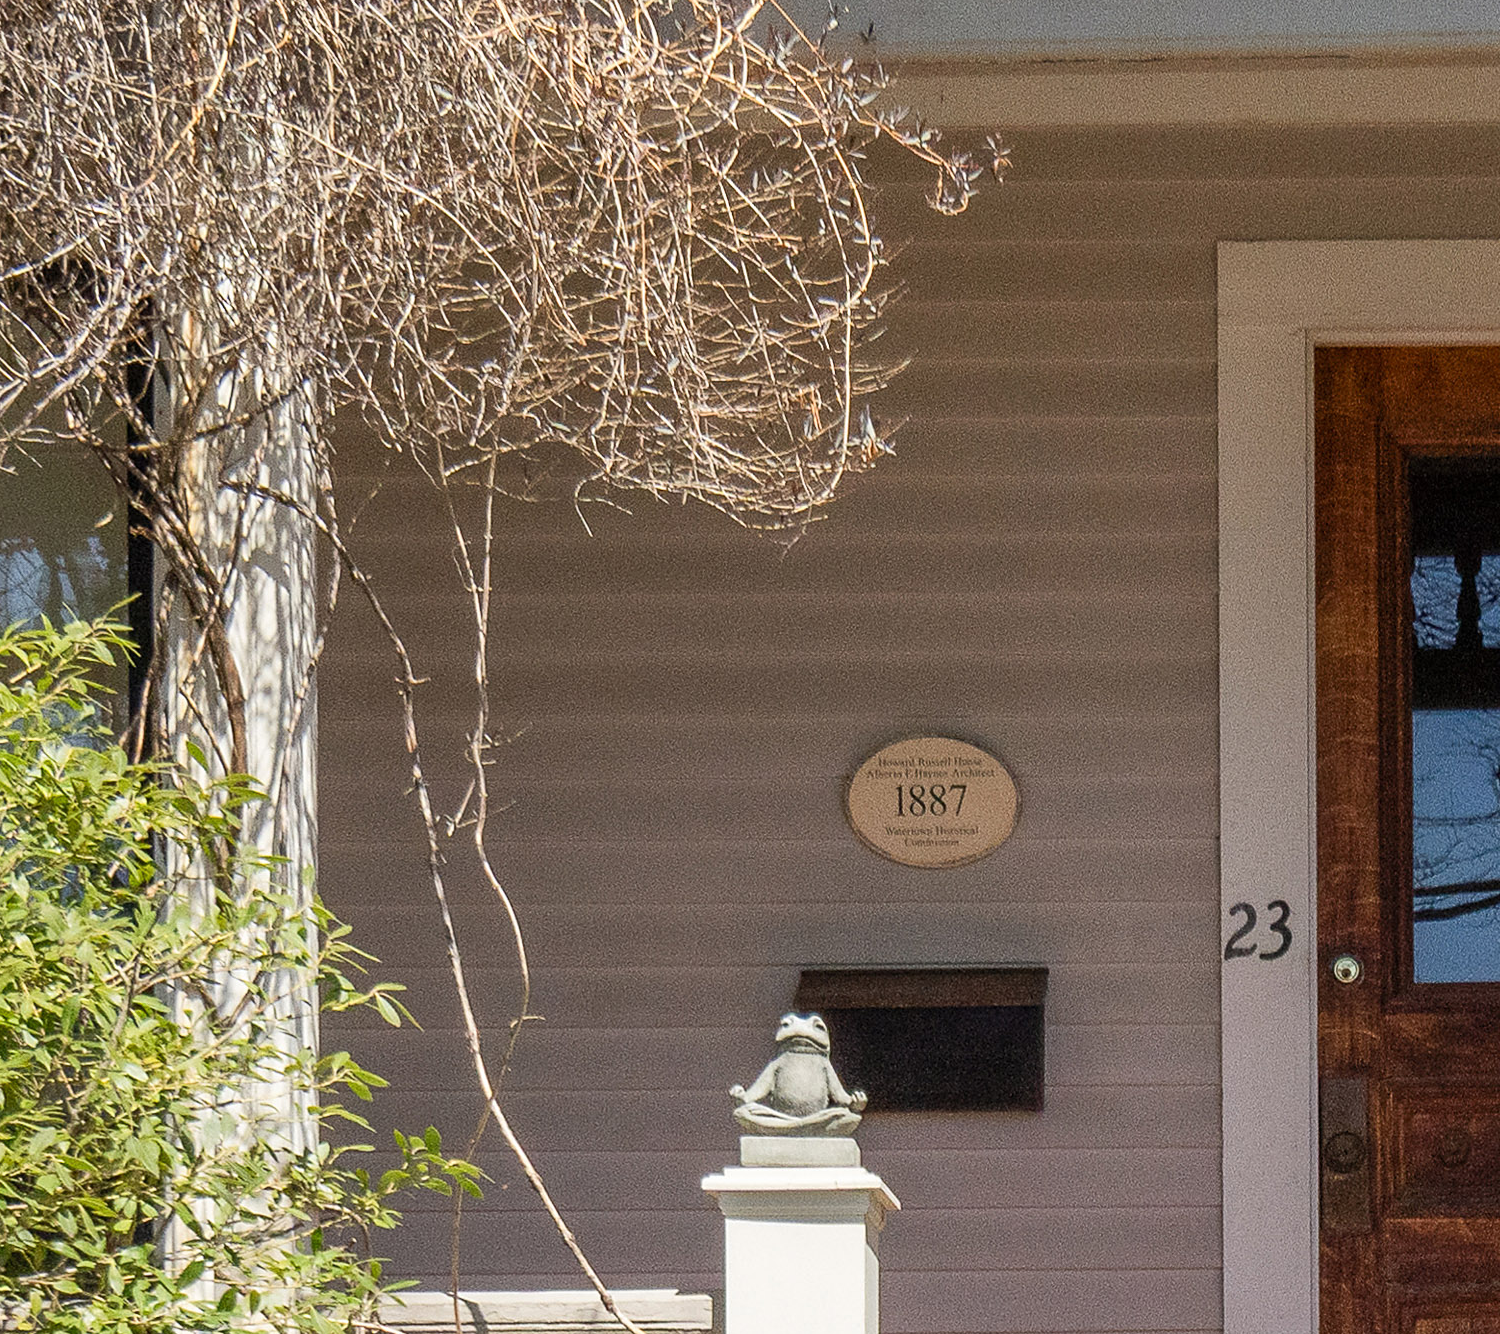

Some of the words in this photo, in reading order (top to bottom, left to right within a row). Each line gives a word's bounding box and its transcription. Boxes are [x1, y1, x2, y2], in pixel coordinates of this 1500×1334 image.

[918, 757, 951, 767] Russell
[896, 784, 967, 817] 1887
[935, 826, 979, 835] Historical
[1225, 900, 1293, 961] 23
